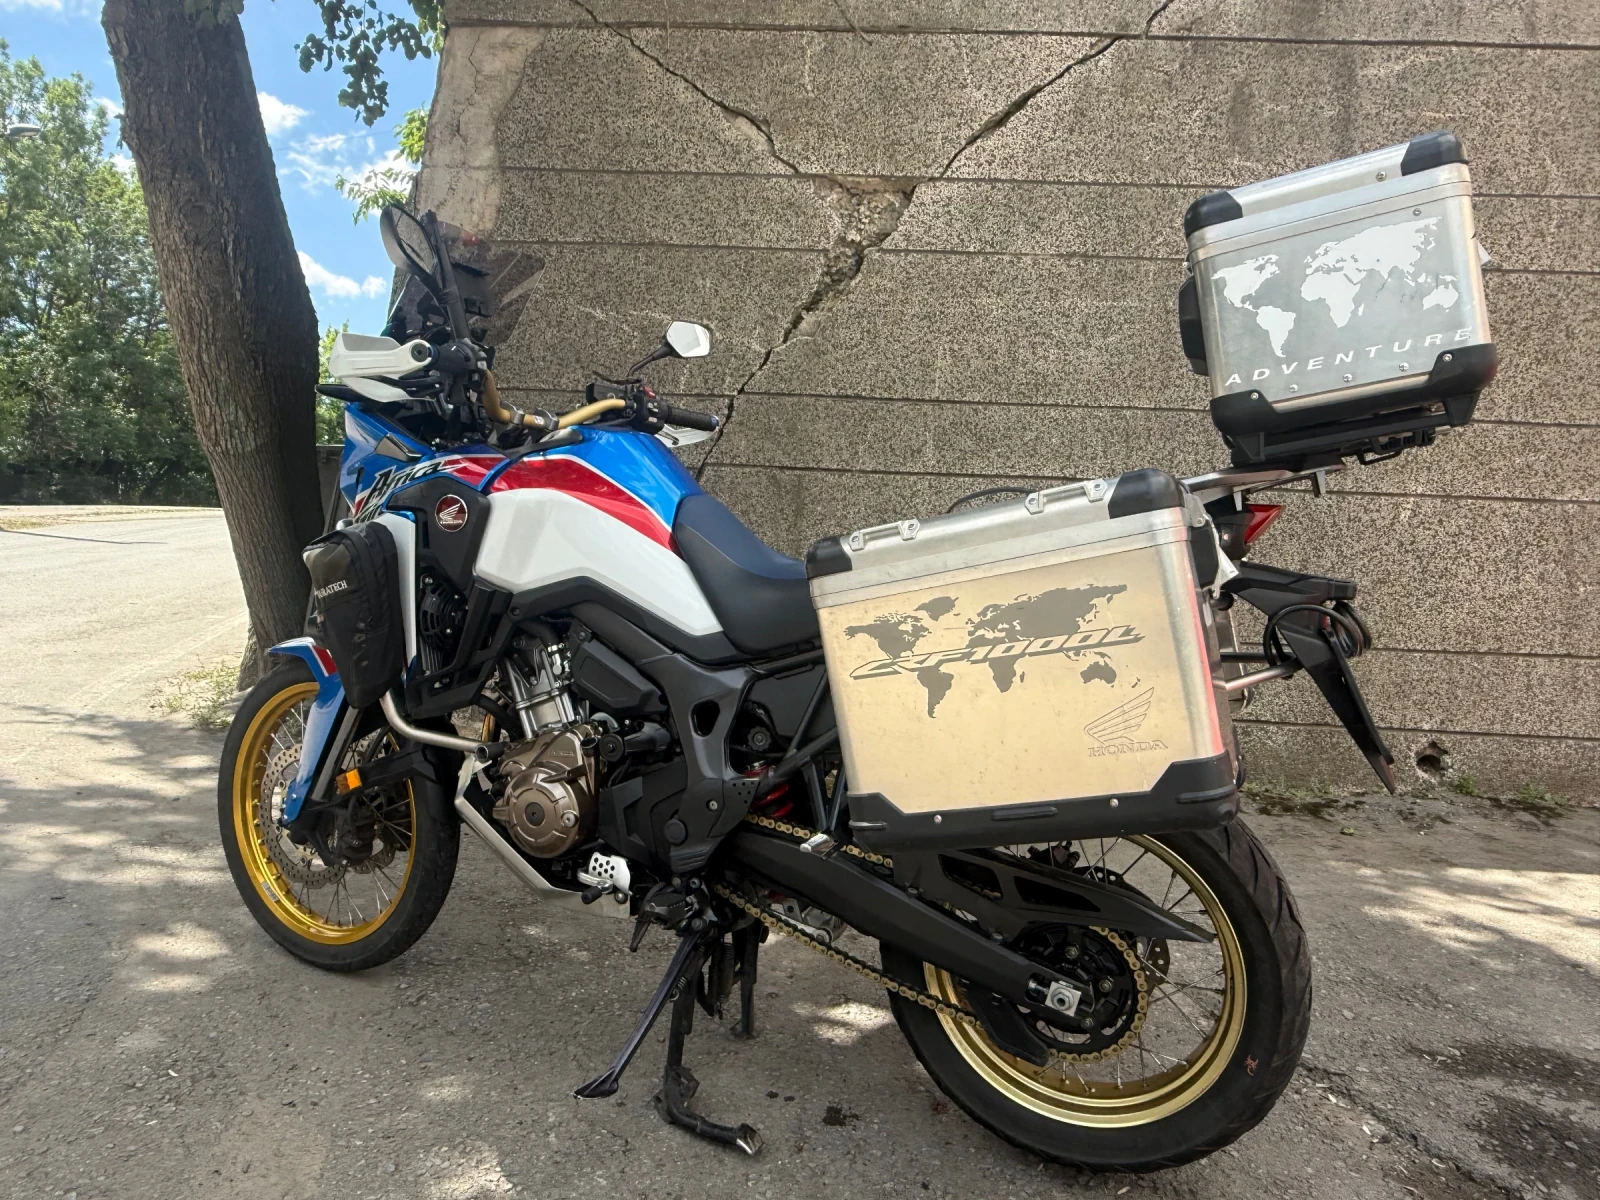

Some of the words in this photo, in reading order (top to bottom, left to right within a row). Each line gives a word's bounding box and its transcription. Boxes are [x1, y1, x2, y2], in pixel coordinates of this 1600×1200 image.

[1225, 327, 1472, 386] ADVENTURE
[358, 461, 441, 510] Africa
[1088, 739, 1168, 757] HONDA
